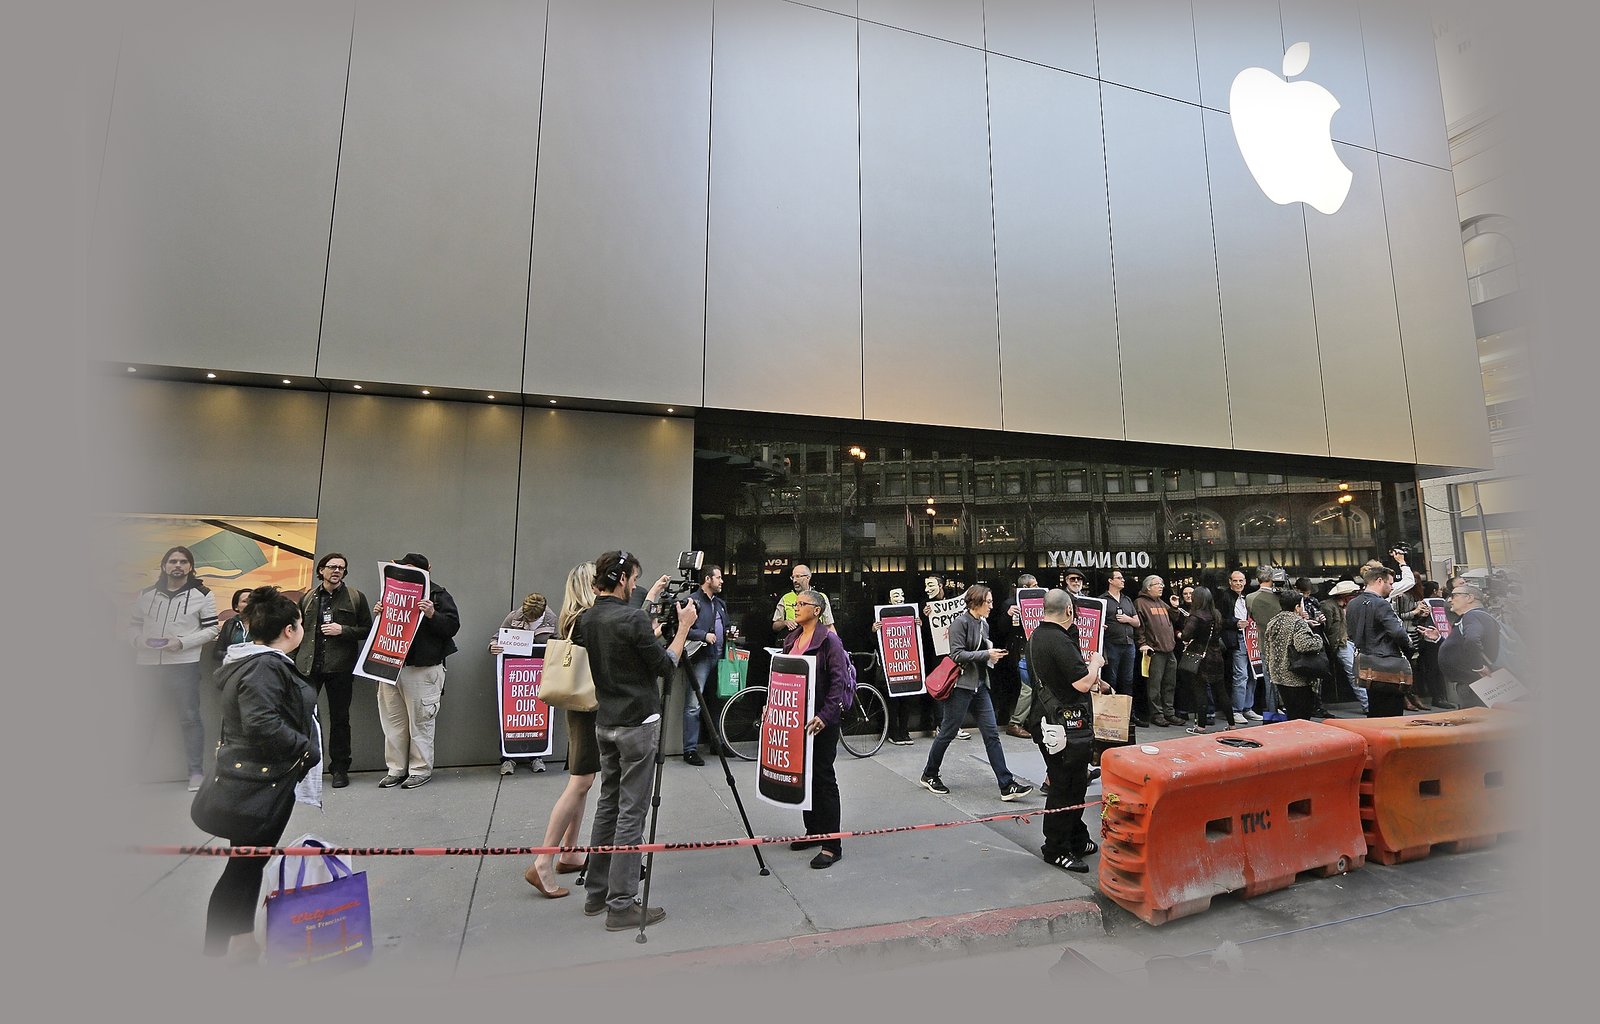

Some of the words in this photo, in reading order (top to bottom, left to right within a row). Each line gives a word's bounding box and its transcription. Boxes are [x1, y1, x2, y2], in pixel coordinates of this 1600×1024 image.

[385, 590, 417, 609] #DON'T
[385, 606, 412, 623] BREAK
[386, 622, 404, 638] OUR
[886, 625, 912, 637] #DON'T
[377, 635, 410, 655] PHONES
[889, 637, 912, 649] BREAK
[893, 649, 909, 661] OUR
[888, 660, 917, 672] PHONES
[515, 699, 536, 712] OUR
[506, 713, 545, 728] PHONES
[768, 727, 789, 748] SAVE
[767, 747, 790, 768] LIVES
[1240, 808, 1272, 834] TPC
